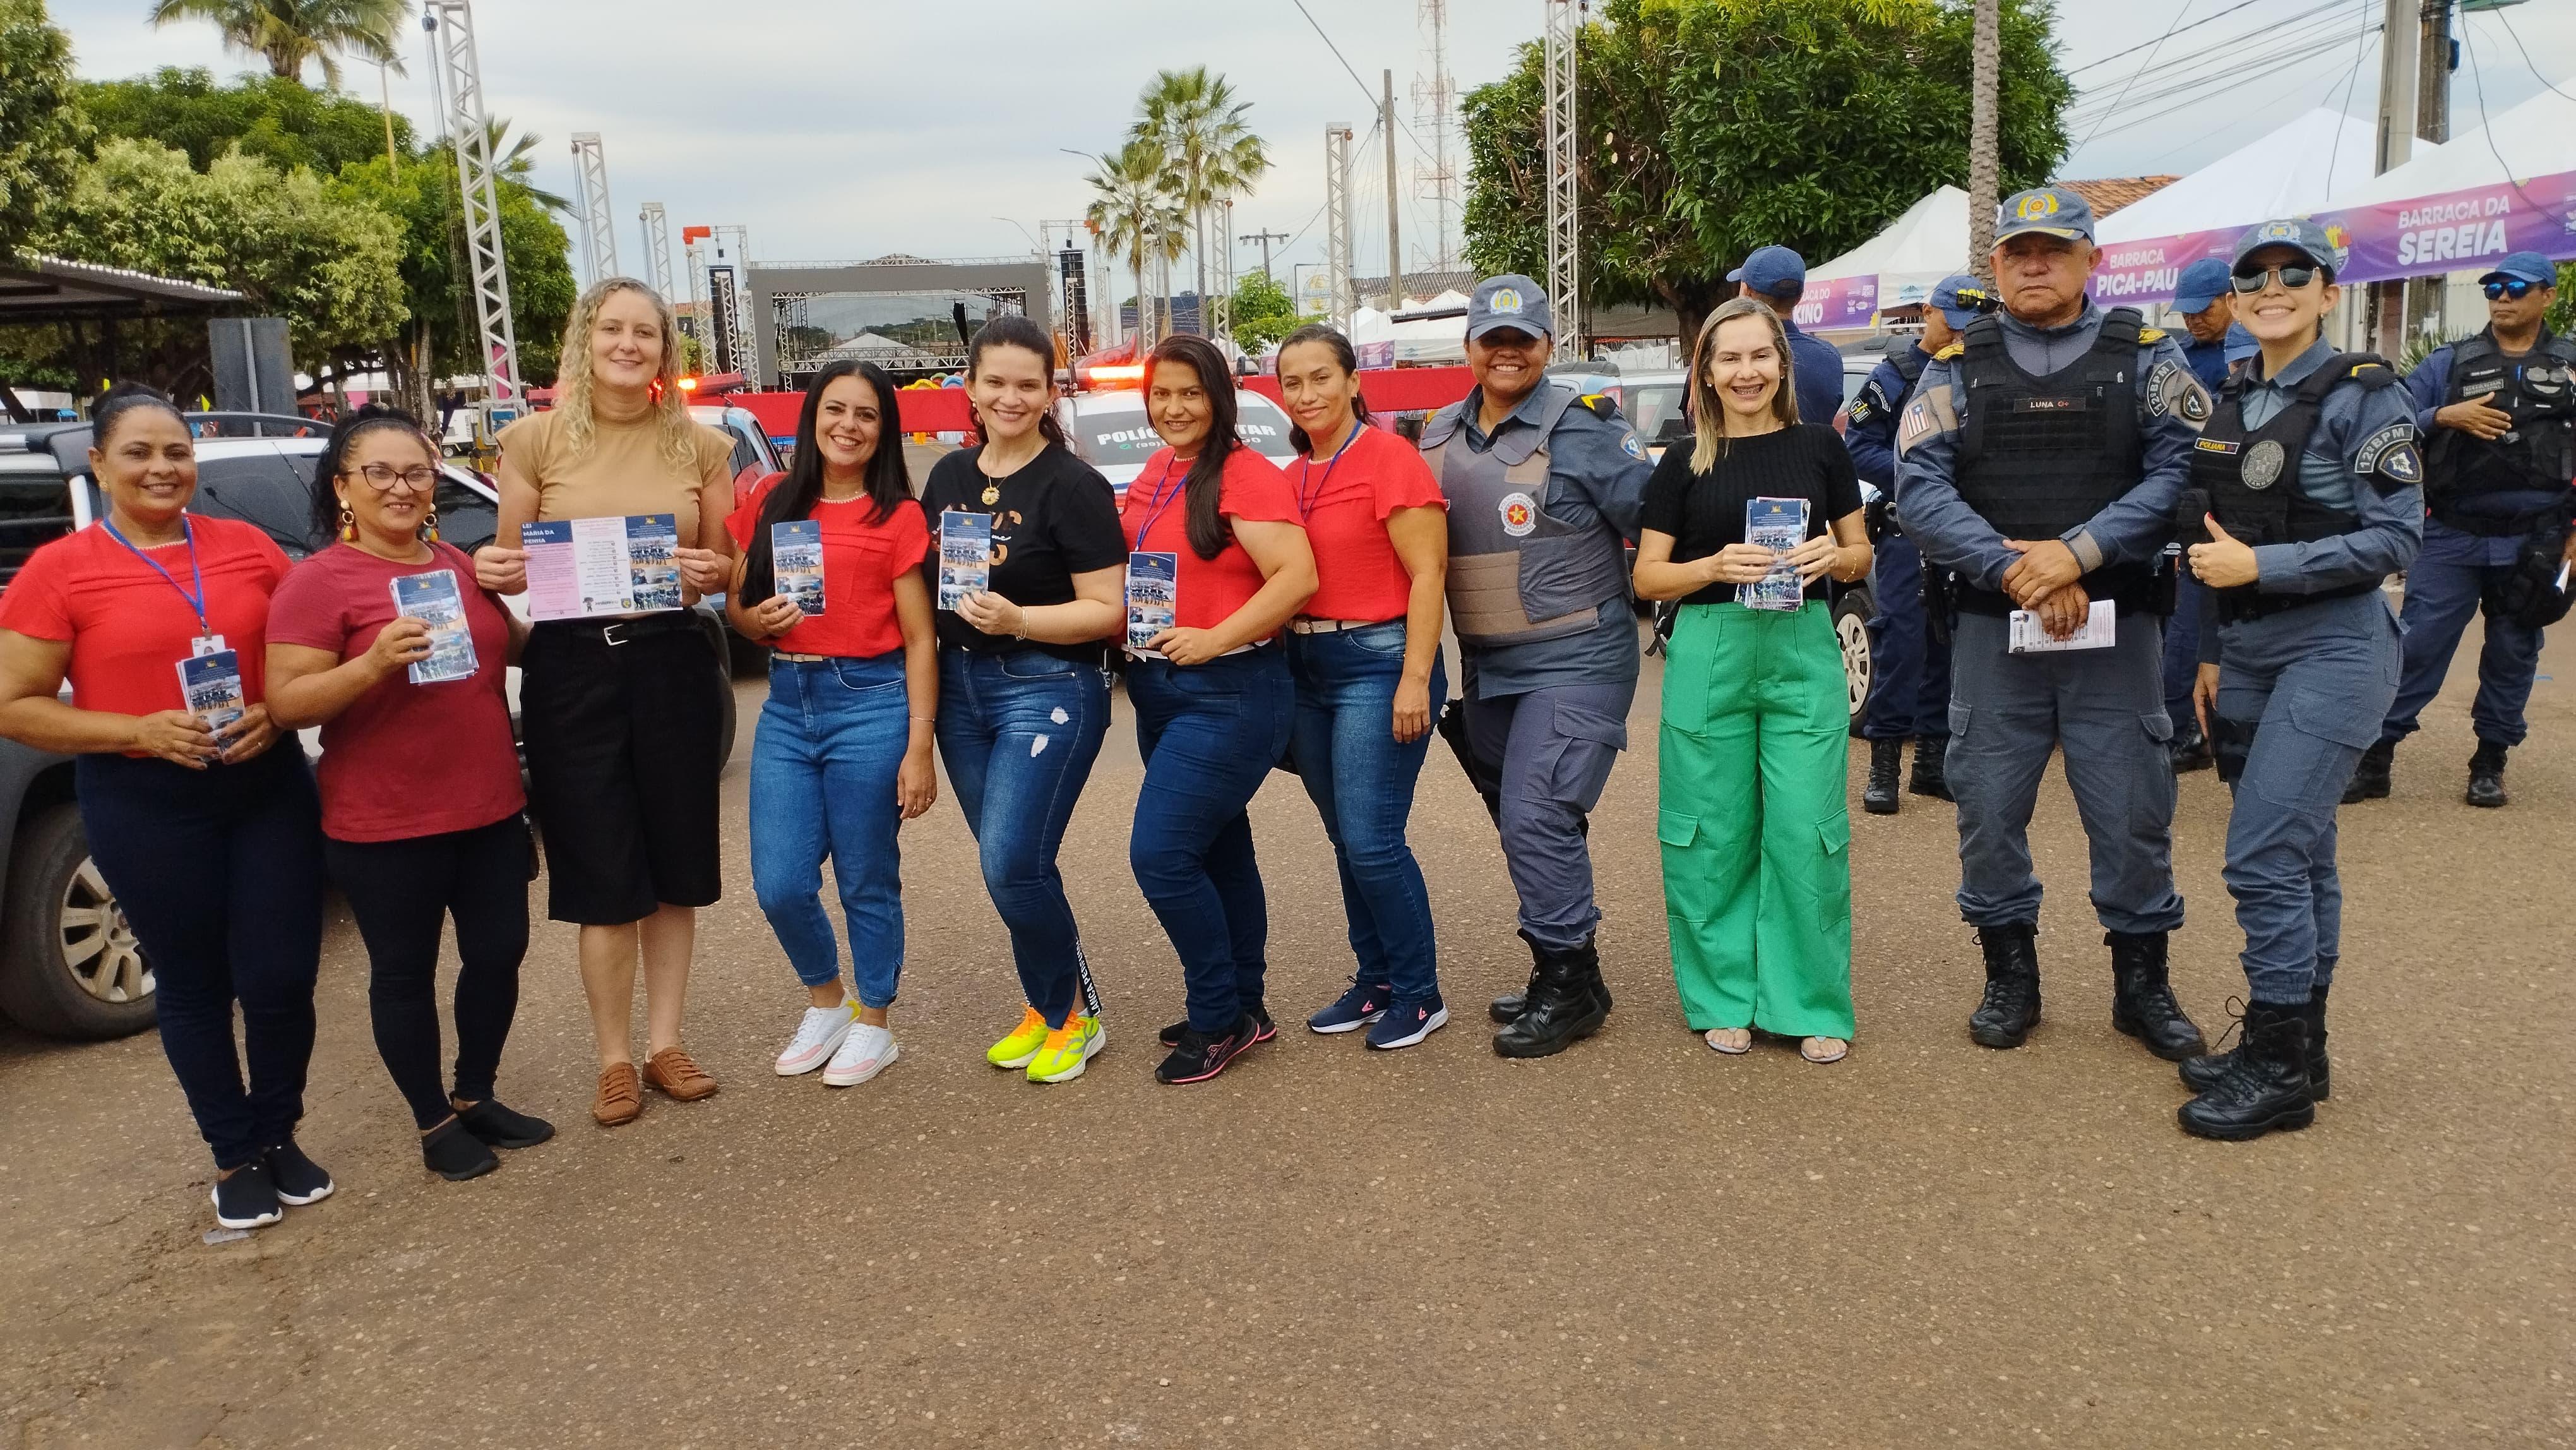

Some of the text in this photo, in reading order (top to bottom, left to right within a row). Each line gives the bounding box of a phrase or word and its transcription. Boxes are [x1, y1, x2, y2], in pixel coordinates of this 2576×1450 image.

[2398, 195, 2511, 229] BARRACA DA
[2397, 219, 2508, 266] SEREIA
[2110, 248, 2166, 269] BARRACA
[1819, 288, 1830, 299] DO
[2096, 267, 2179, 297] PICA-PAU
